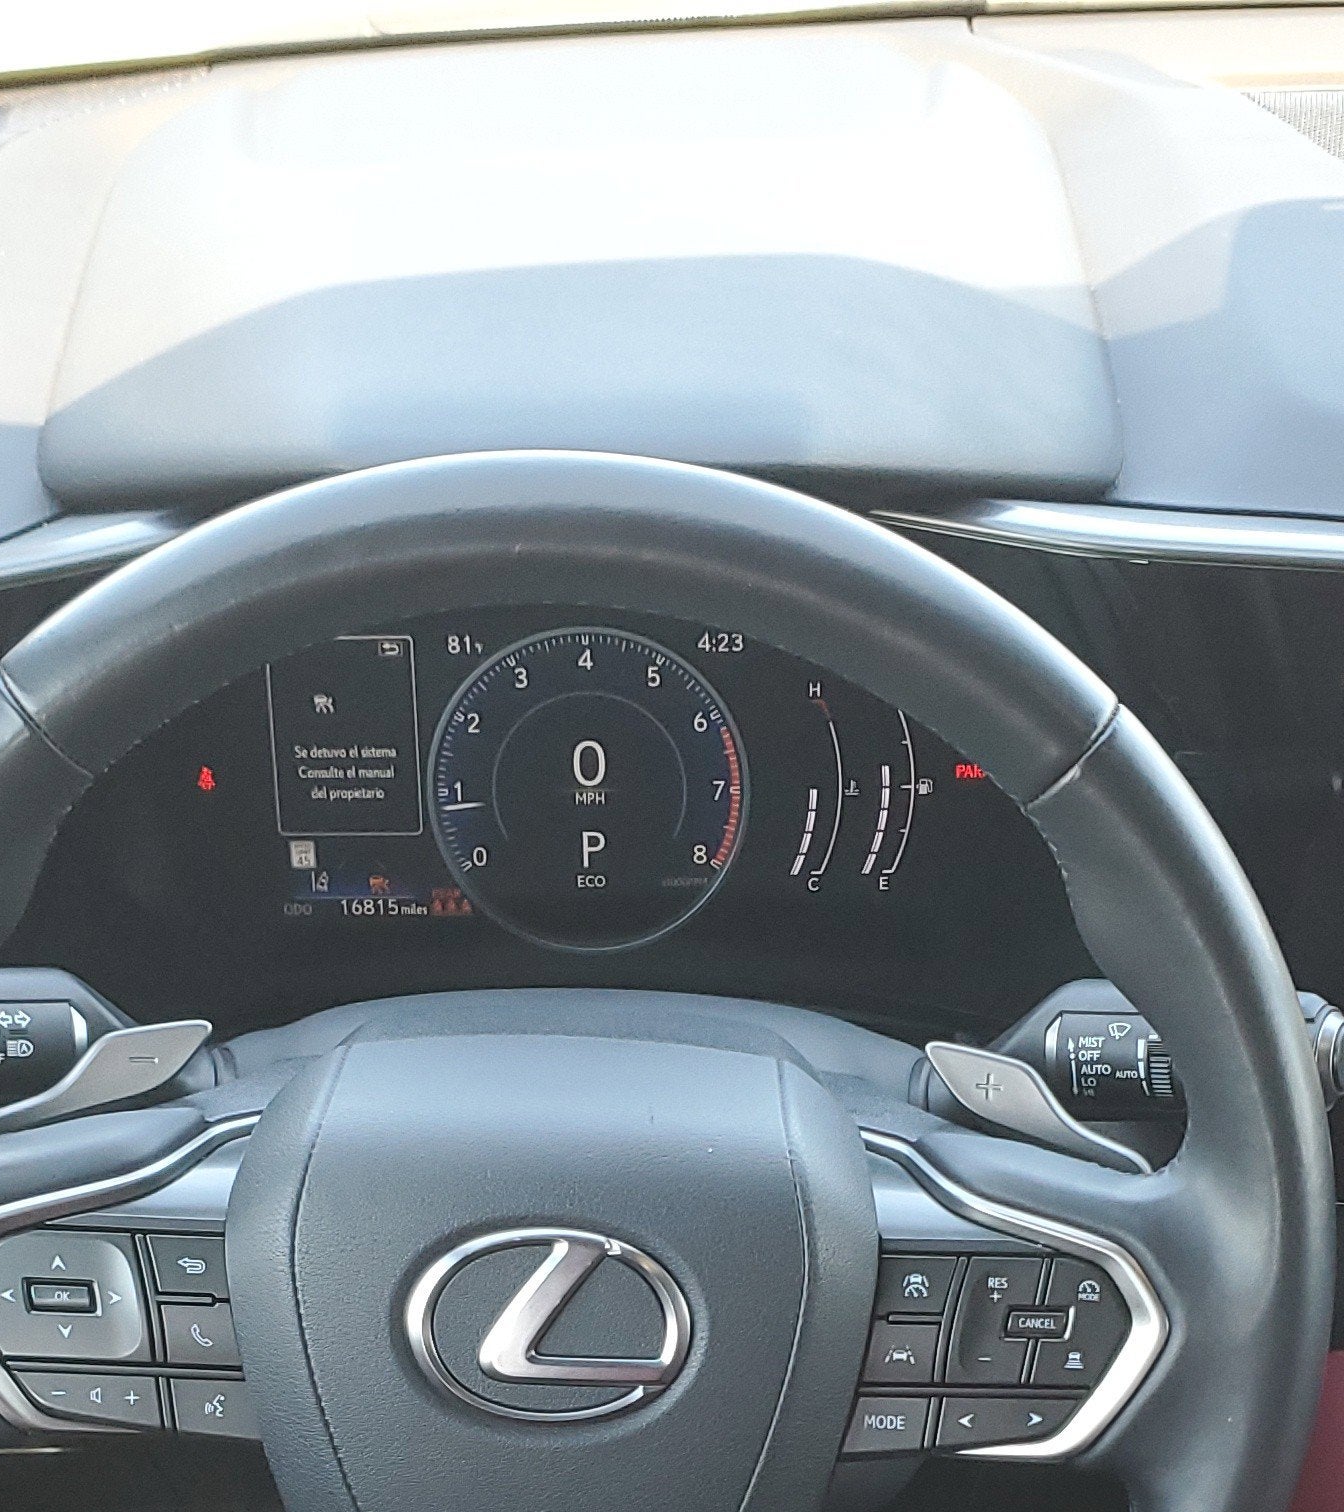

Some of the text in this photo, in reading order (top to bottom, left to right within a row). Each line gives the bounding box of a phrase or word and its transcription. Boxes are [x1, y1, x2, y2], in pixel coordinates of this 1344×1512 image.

[697, 633, 744, 652] 4:23
[578, 649, 593, 670] 4
[515, 668, 528, 689] 3
[647, 666, 660, 687] 5
[809, 681, 821, 697] H
[468, 713, 480, 733] 2
[693, 712, 707, 732] 6
[295, 744, 396, 758] Se detuvo el sistema
[298, 763, 395, 778] Consulte el manual
[573, 740, 606, 787] 0
[956, 764, 986, 779] PAR
[311, 785, 385, 802] del propietario
[454, 781, 462, 802] 1
[712, 780, 724, 801] 7
[575, 792, 605, 805] MPH
[473, 848, 487, 866] 0
[582, 831, 606, 868] P
[693, 844, 707, 864] 8
[576, 875, 606, 888] ECO
[808, 877, 820, 891] C
[879, 877, 890, 891] E
[284, 899, 428, 915] ODO 16815 miles
[1078, 1036, 1106, 1048] MIST
[1078, 1050, 1101, 1061] OFF
[1081, 1064, 1112, 1075] AUTO
[1116, 1070, 1138, 1079] AUTO
[1081, 1077, 1097, 1087] LO
[987, 1276, 1009, 1289] RES
[54, 1291, 70, 1302] OK
[1077, 1292, 1101, 1303] MODE
[1018, 1317, 1057, 1330] CANCEL
[864, 1414, 906, 1431] MODE
